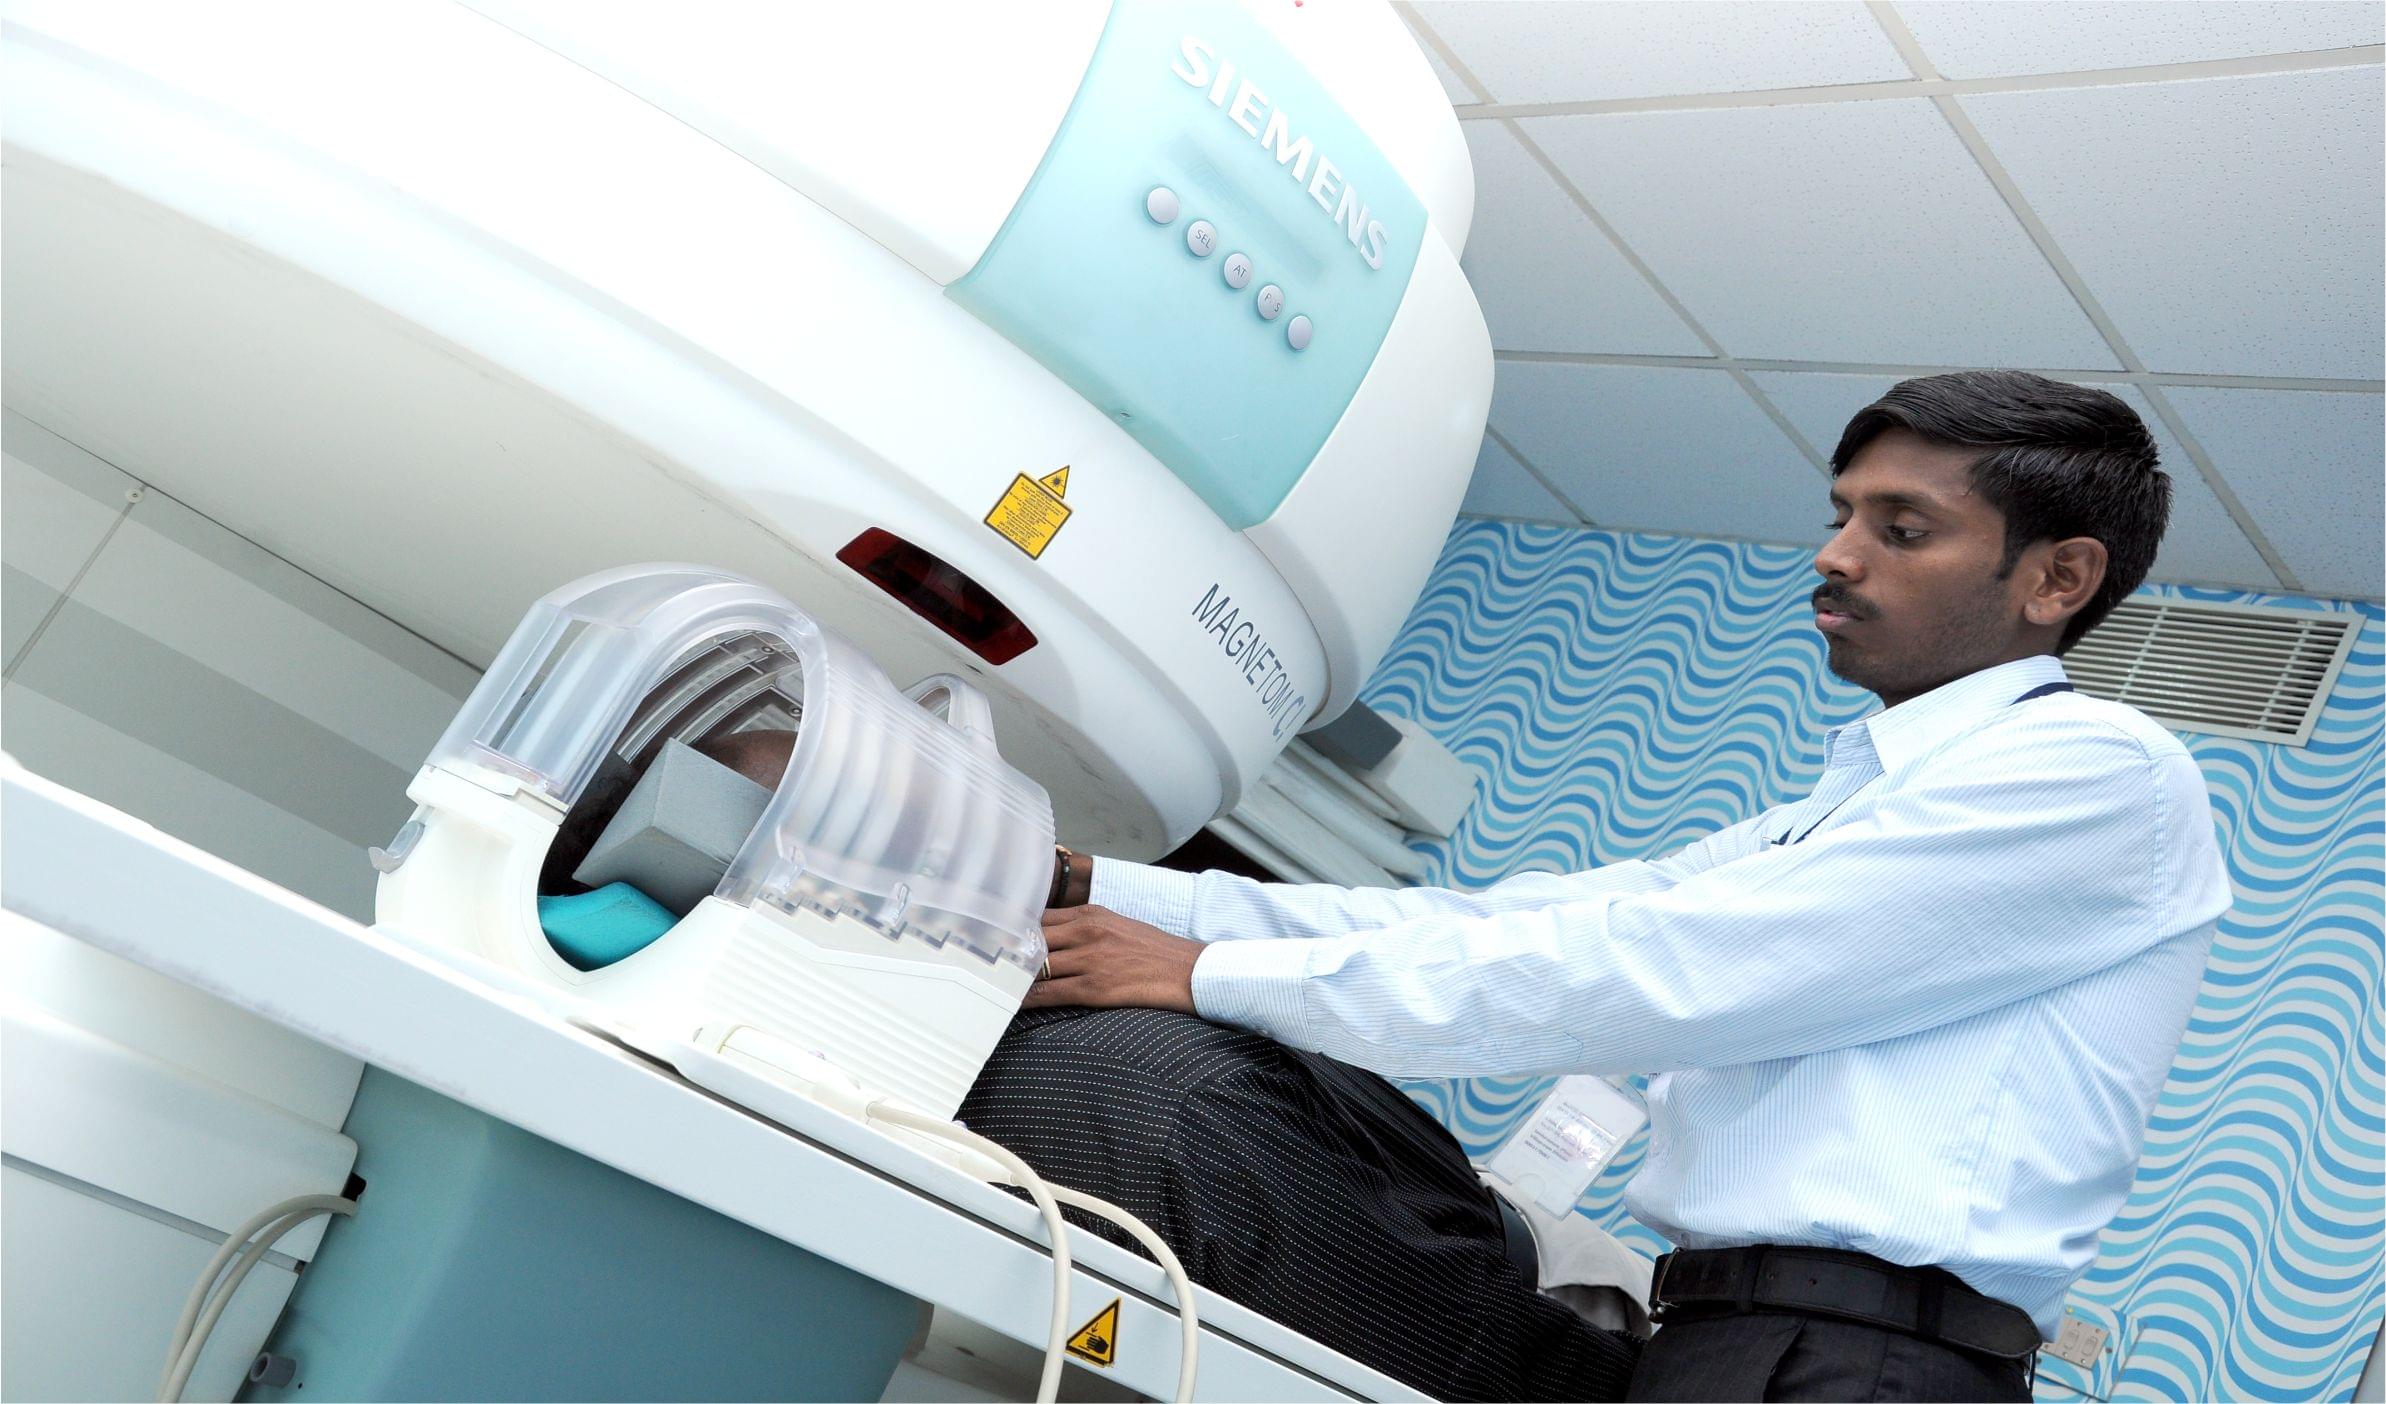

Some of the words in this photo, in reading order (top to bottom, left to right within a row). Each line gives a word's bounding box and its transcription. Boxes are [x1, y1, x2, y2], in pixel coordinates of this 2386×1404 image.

[1170, 35, 1388, 271] SIEMENS
[1195, 229, 1211, 249] SEL
[1233, 264, 1247, 278] AT
[1191, 582, 1294, 720] MAGNETOM
